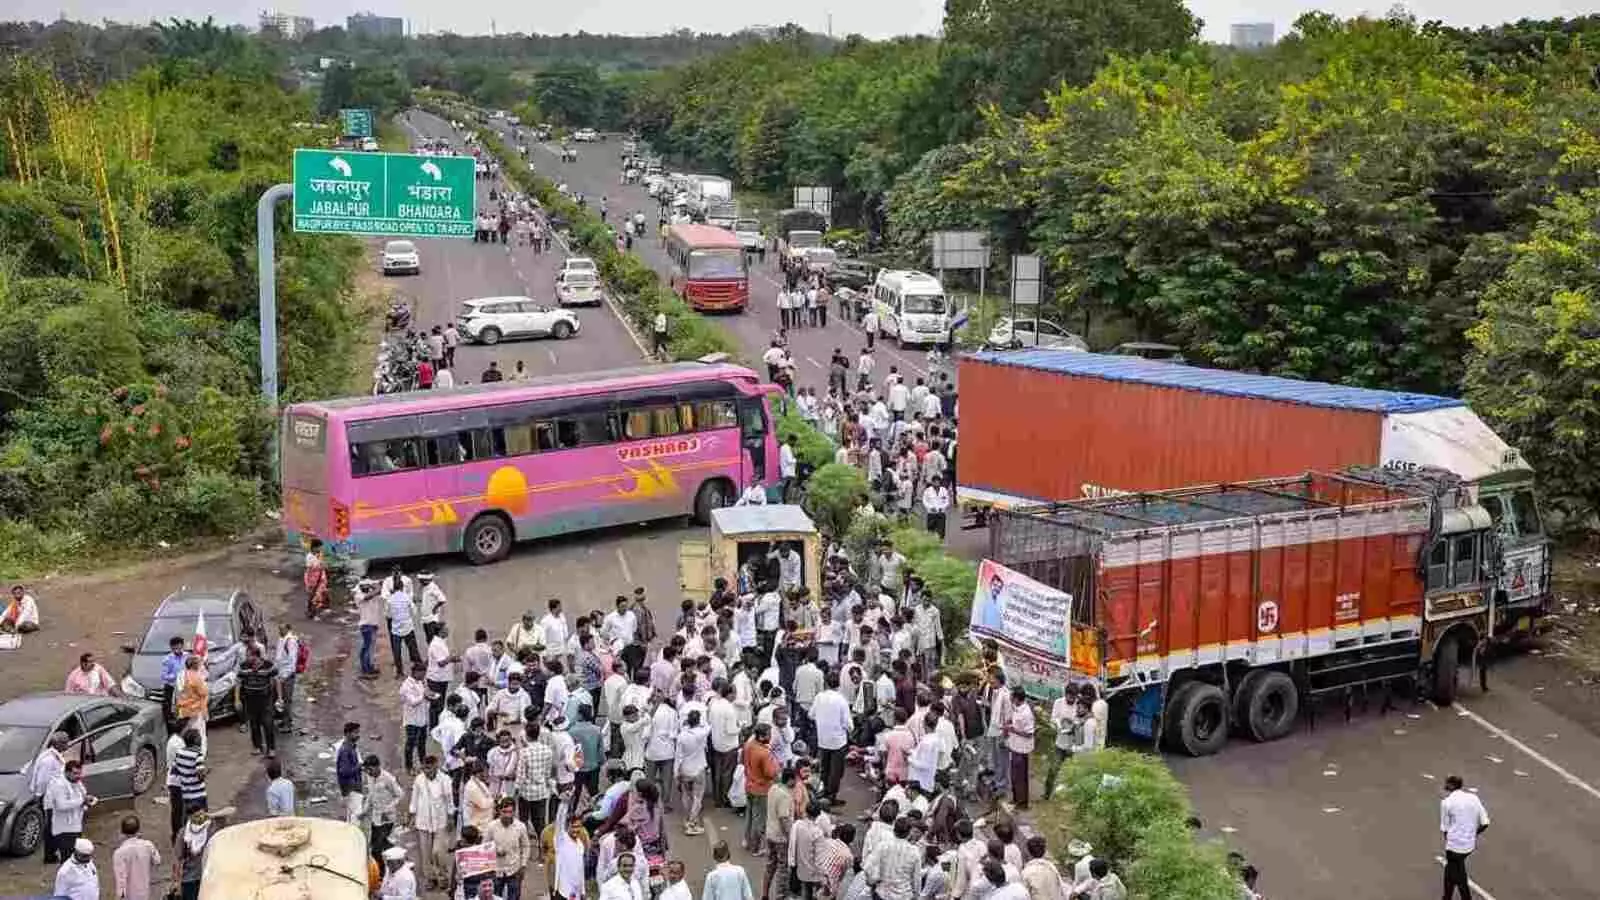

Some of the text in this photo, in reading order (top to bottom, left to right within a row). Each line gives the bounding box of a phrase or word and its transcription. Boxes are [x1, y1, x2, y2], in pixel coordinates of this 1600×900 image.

[310, 178, 371, 201] जबलपुर
[407, 181, 453, 201] भंडारा
[310, 200, 369, 217] JABALPUR
[398, 203, 461, 219] BHANDARA
[374, 221, 399, 233] ROAD
[400, 222, 422, 233] OPEN
[423, 223, 435, 234] TO
[436, 223, 472, 235] TRAFFIC
[617, 439, 700, 460] YASHRAJ
